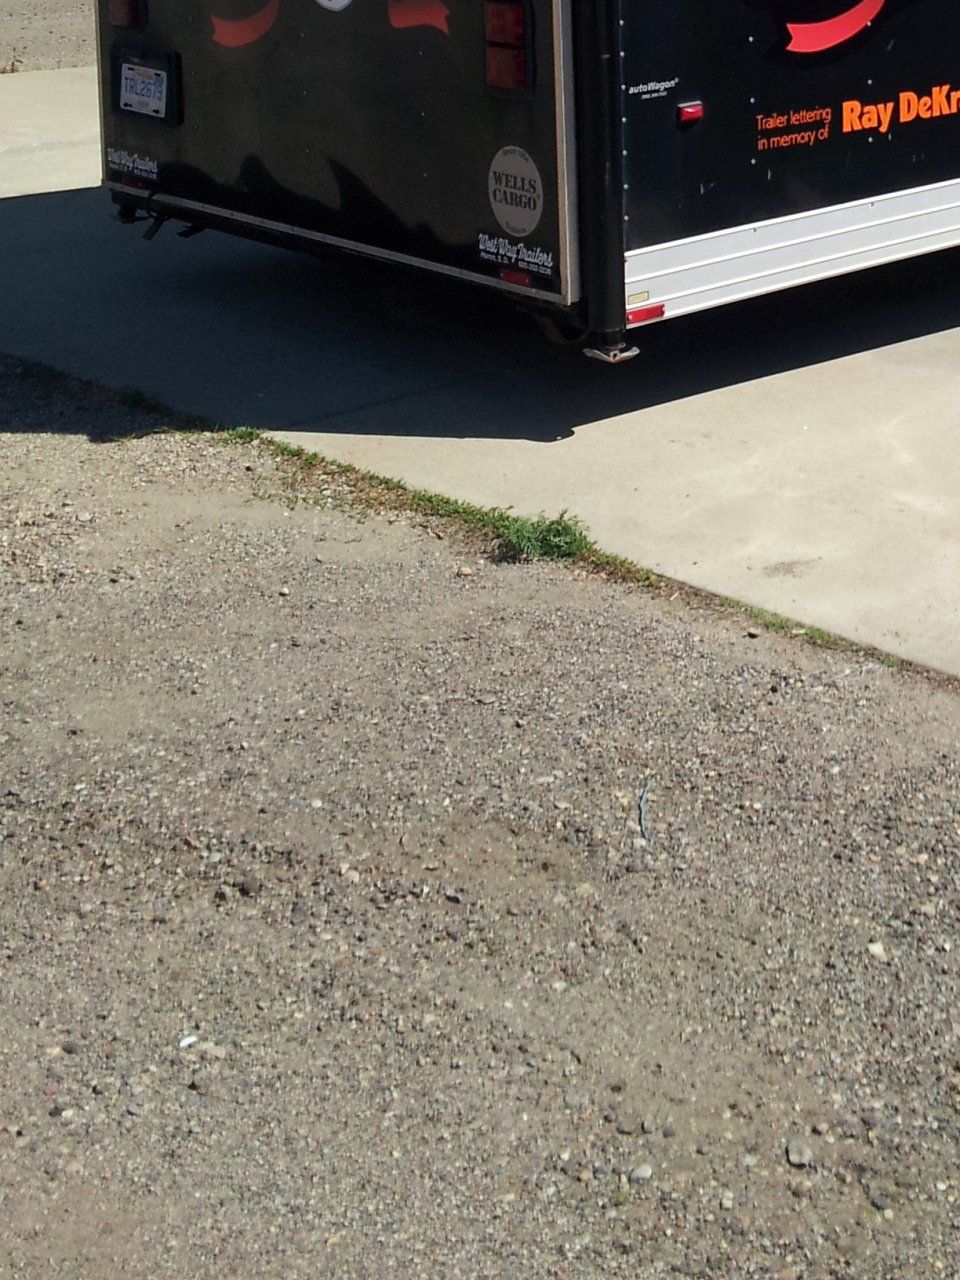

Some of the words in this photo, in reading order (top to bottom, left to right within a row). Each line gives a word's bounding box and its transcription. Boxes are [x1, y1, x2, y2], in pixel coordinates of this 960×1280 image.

[756, 113, 789, 131] Trailer
[790, 106, 832, 126] lettering
[842, 99, 895, 134] Ray
[758, 136, 768, 150] in
[770, 130, 816, 147] memory
[818, 125, 830, 140] of
[493, 171, 537, 195] WELLS
[493, 188, 537, 211] CARGO
